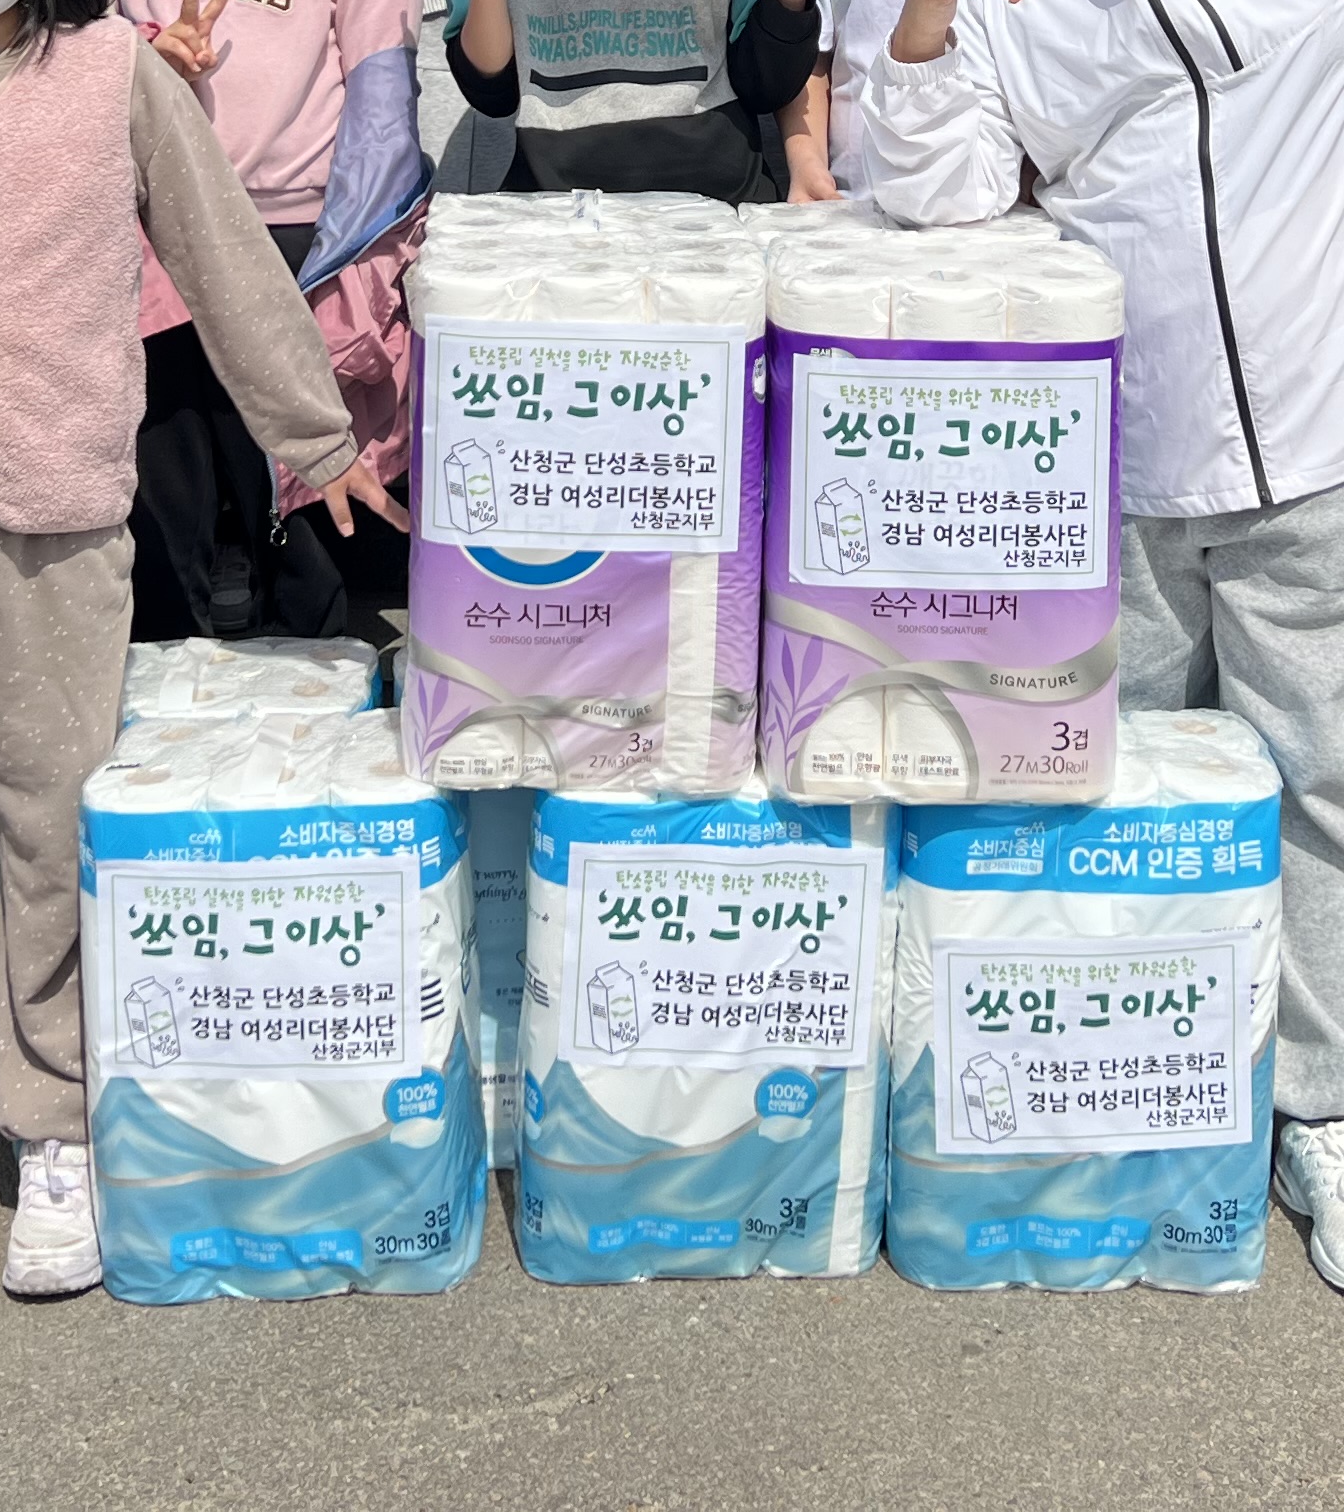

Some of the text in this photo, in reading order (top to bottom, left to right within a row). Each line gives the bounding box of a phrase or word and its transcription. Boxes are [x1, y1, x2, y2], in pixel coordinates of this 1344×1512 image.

[840, 384, 1061, 410] 탄소중립 실천을 위한 자원순환
[881, 490, 1088, 515] 산청군 단성초등학교
[881, 523, 1088, 548] 경남 여성리더봉사단
[1003, 549, 1087, 568] 산청군지부
[464, 602, 612, 629] 순수 시그니처
[870, 592, 1018, 621] 순수 시그니처
[489, 634, 584, 646] SOONSOO SIGNATURE
[897, 625, 989, 636] SOONSOO SIGNATURE
[989, 671, 1078, 690] SIGNATURE
[582, 704, 652, 719] SIGNATURE
[1051, 721, 1089, 751] 3겹
[279, 819, 415, 847] 소비자중심경영
[700, 822, 803, 840] 소비자중심경영
[1103, 820, 1234, 844] 소비자중심경영
[968, 838, 1045, 858] 소비자중심
[1069, 840, 1264, 879] CCM 인증 획득
[396, 1084, 438, 1103] 100%
[767, 1084, 810, 1100] 100%
[1209, 1199, 1238, 1221] 3겹
